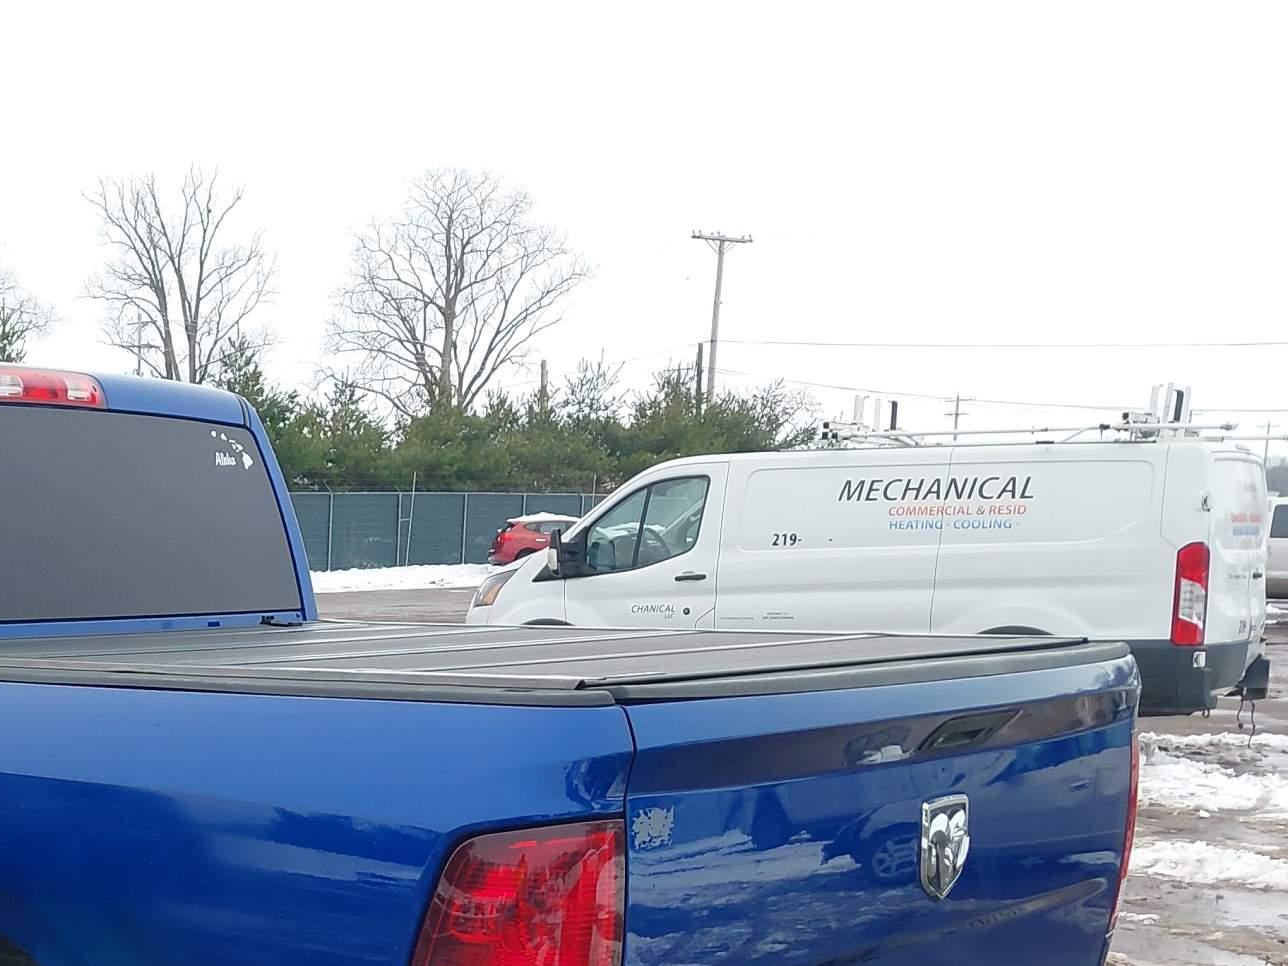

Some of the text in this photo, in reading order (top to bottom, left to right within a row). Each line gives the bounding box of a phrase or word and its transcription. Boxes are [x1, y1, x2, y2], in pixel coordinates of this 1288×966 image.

[838, 476, 1035, 502] MECHANICAL
[888, 504, 1027, 517] COMMERCIAL & RESID
[889, 519, 1013, 530] HEATING COOLING
[631, 604, 676, 614] CHANICAL
